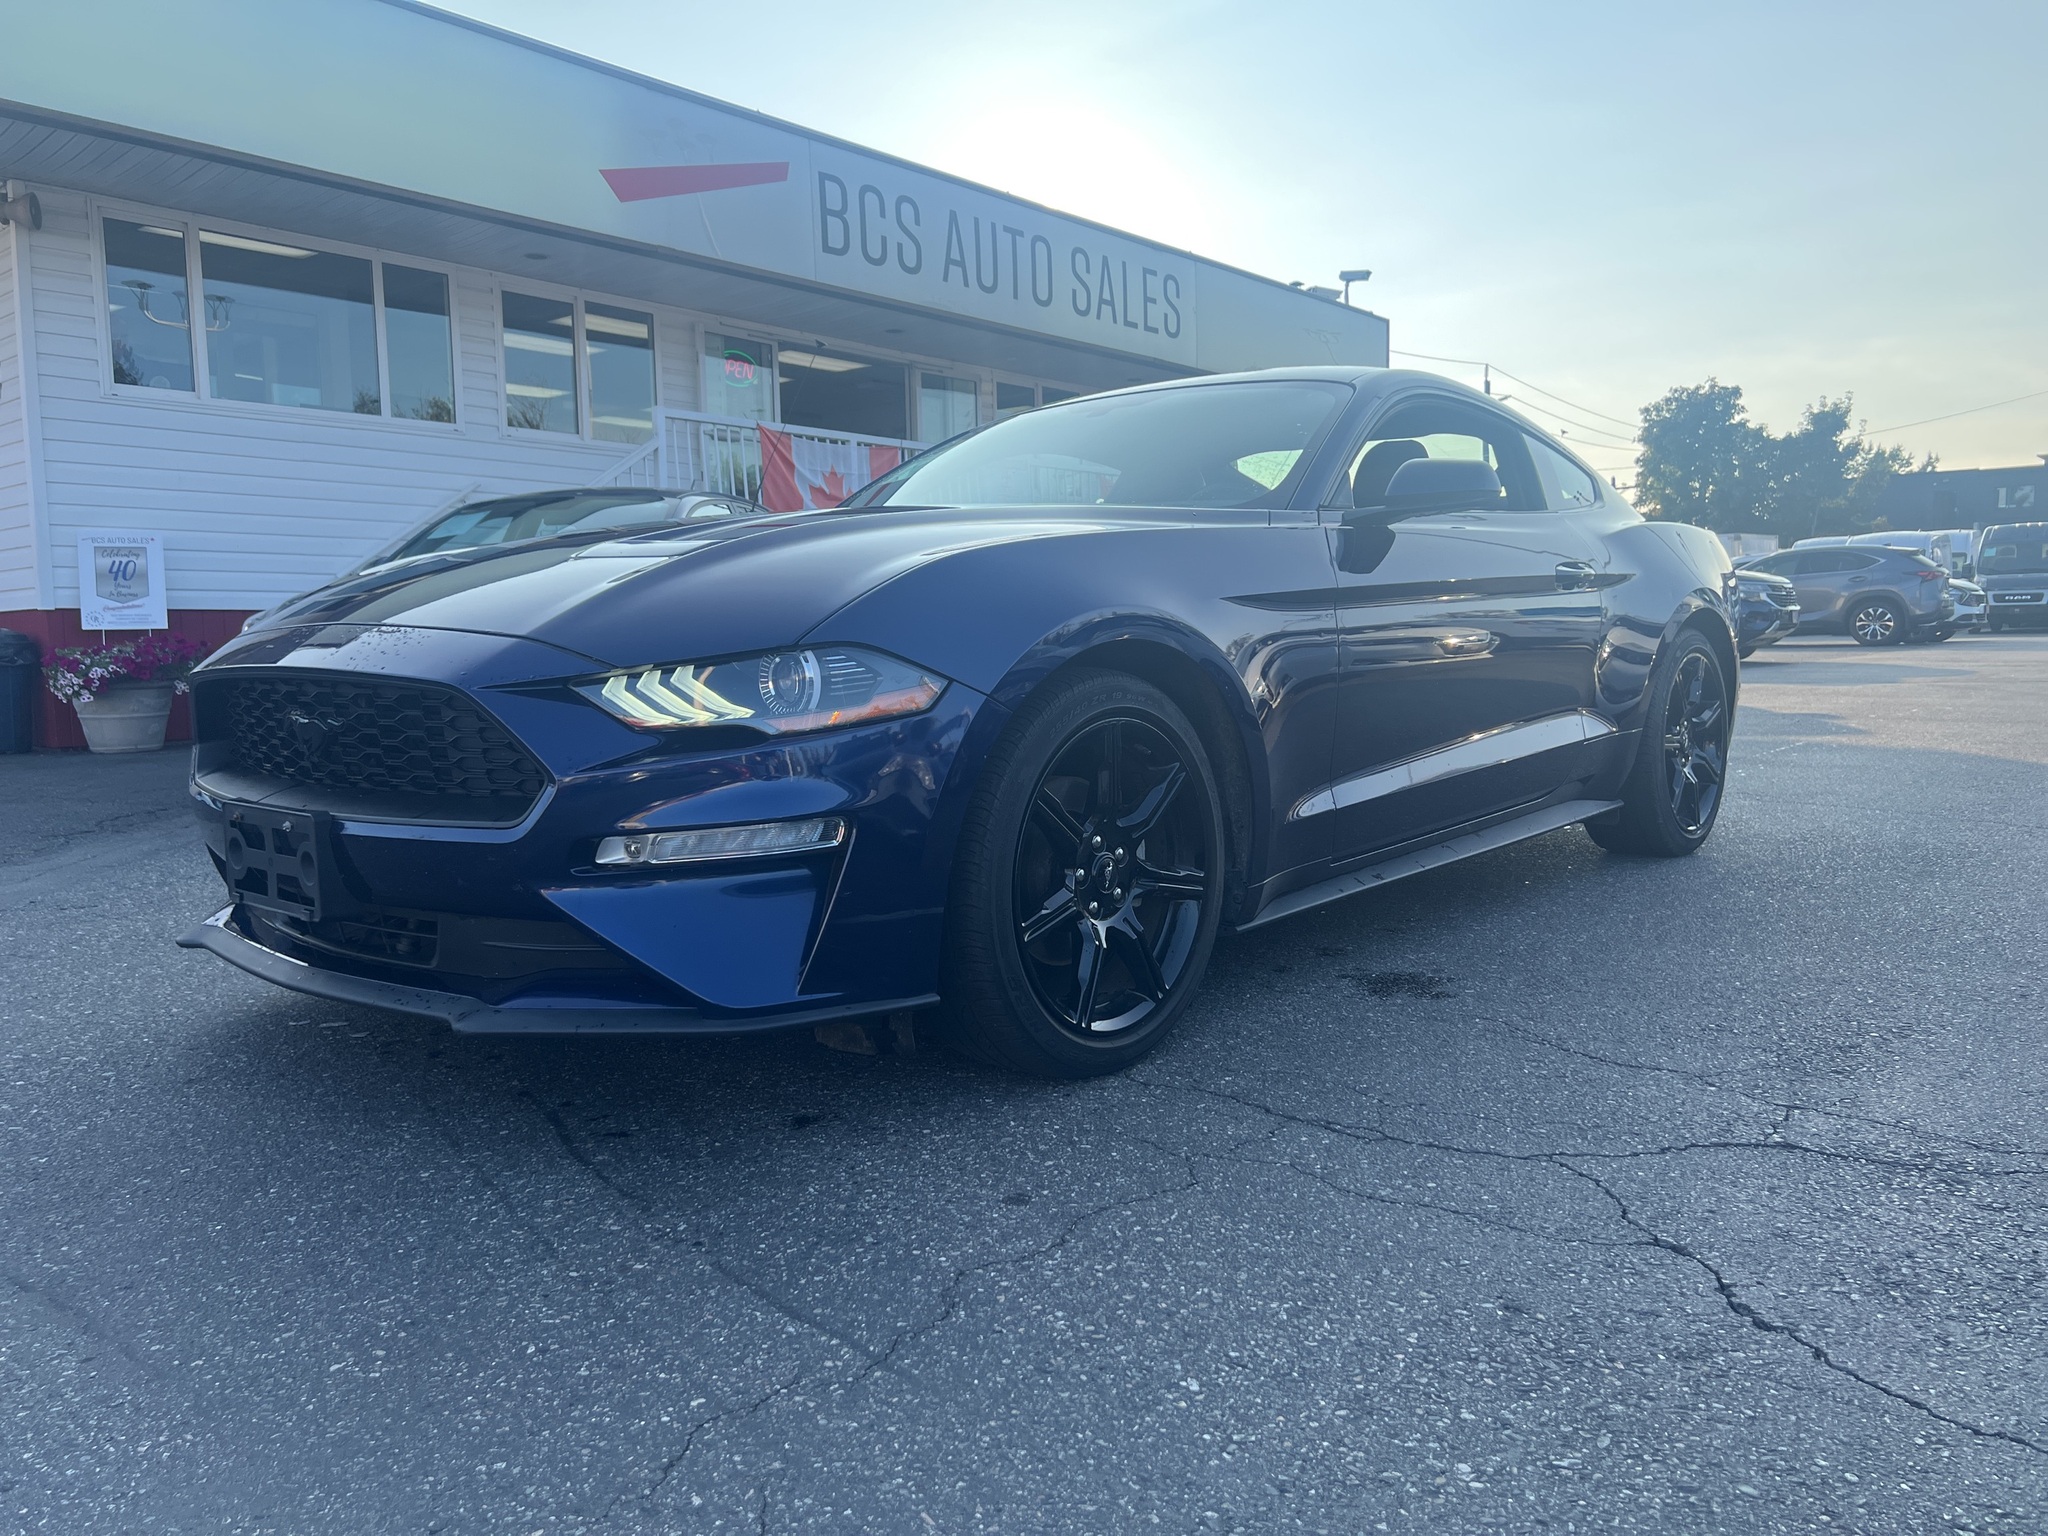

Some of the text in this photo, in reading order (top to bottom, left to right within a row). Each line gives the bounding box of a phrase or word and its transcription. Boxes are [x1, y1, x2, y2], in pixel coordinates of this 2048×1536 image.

[817, 170, 1182, 340] BCS AUTO SALES
[725, 359, 754, 379] PEN
[108, 560, 137, 581] 40
[1112, 691, 1123, 700] 19
